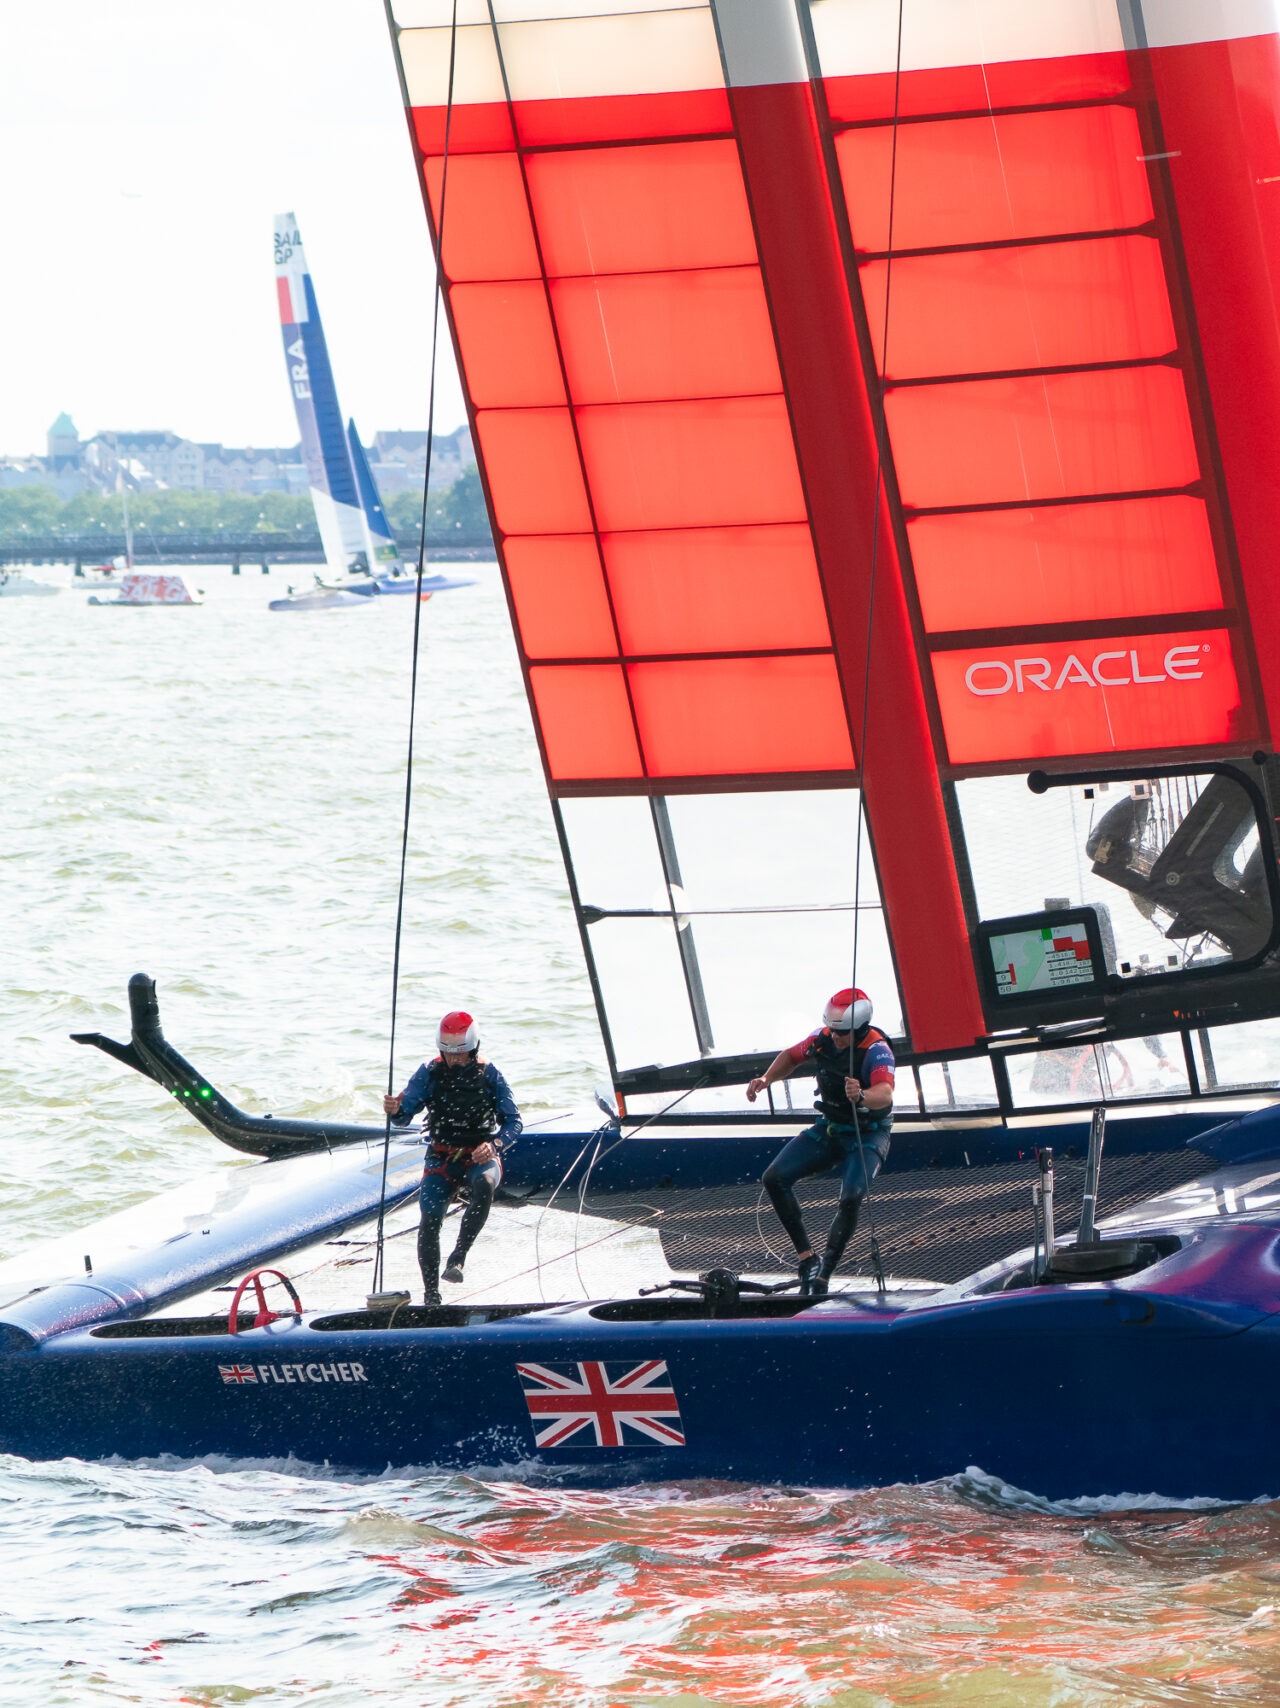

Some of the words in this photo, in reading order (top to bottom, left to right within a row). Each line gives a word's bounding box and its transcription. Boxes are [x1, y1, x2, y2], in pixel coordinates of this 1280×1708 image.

[274, 248, 293, 265] GP
[287, 338, 312, 399] FRA
[257, 1362, 369, 1384] FLETCHER
